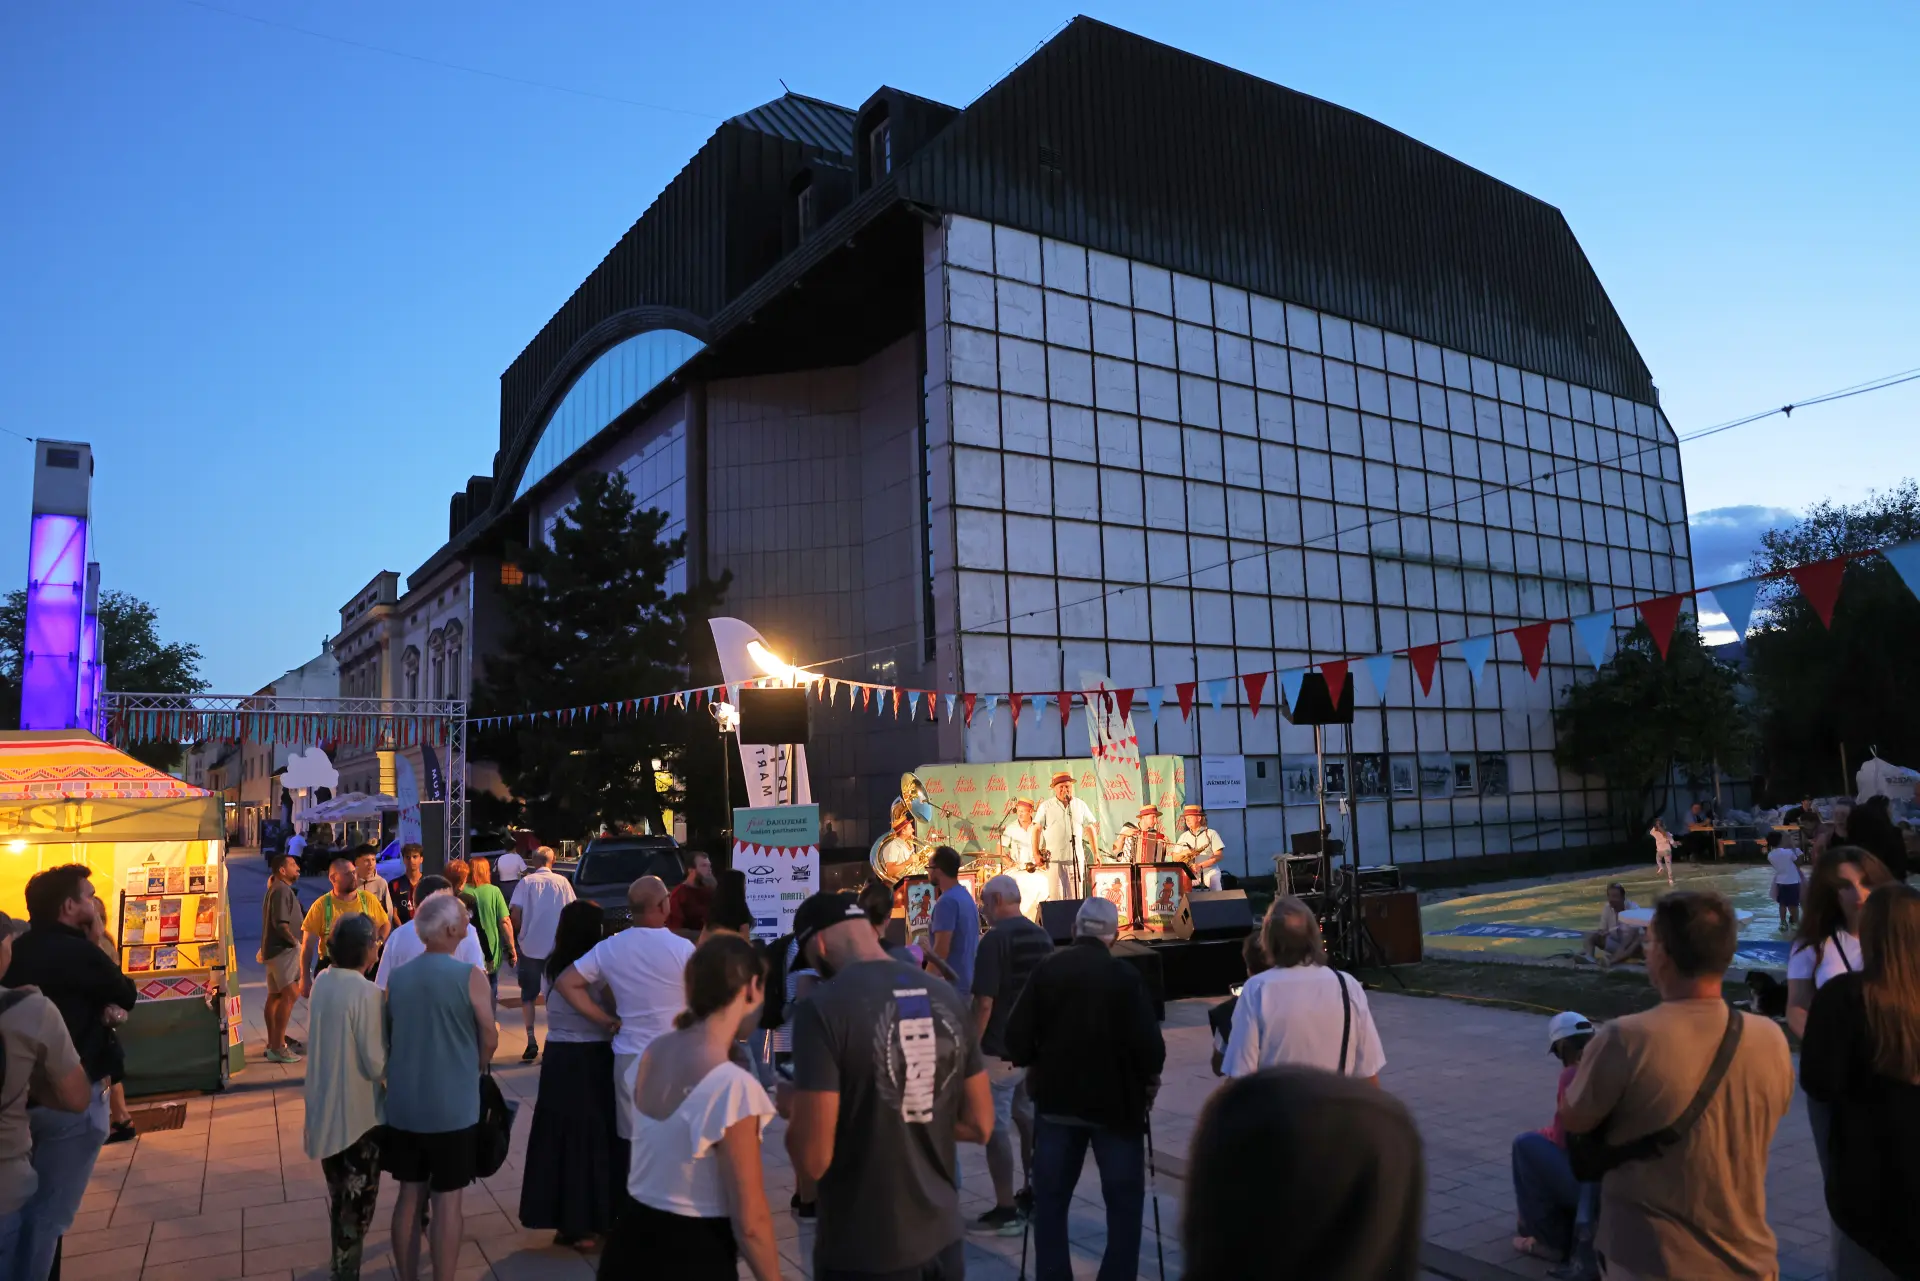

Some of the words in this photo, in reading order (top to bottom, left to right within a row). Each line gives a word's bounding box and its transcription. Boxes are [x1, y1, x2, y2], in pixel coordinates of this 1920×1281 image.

[954, 776, 973, 790] fest
[986, 774, 1005, 788] fest
[1017, 773, 1036, 787] fest
[971, 800, 989, 814] fest
[747, 876, 782, 885] HERY
